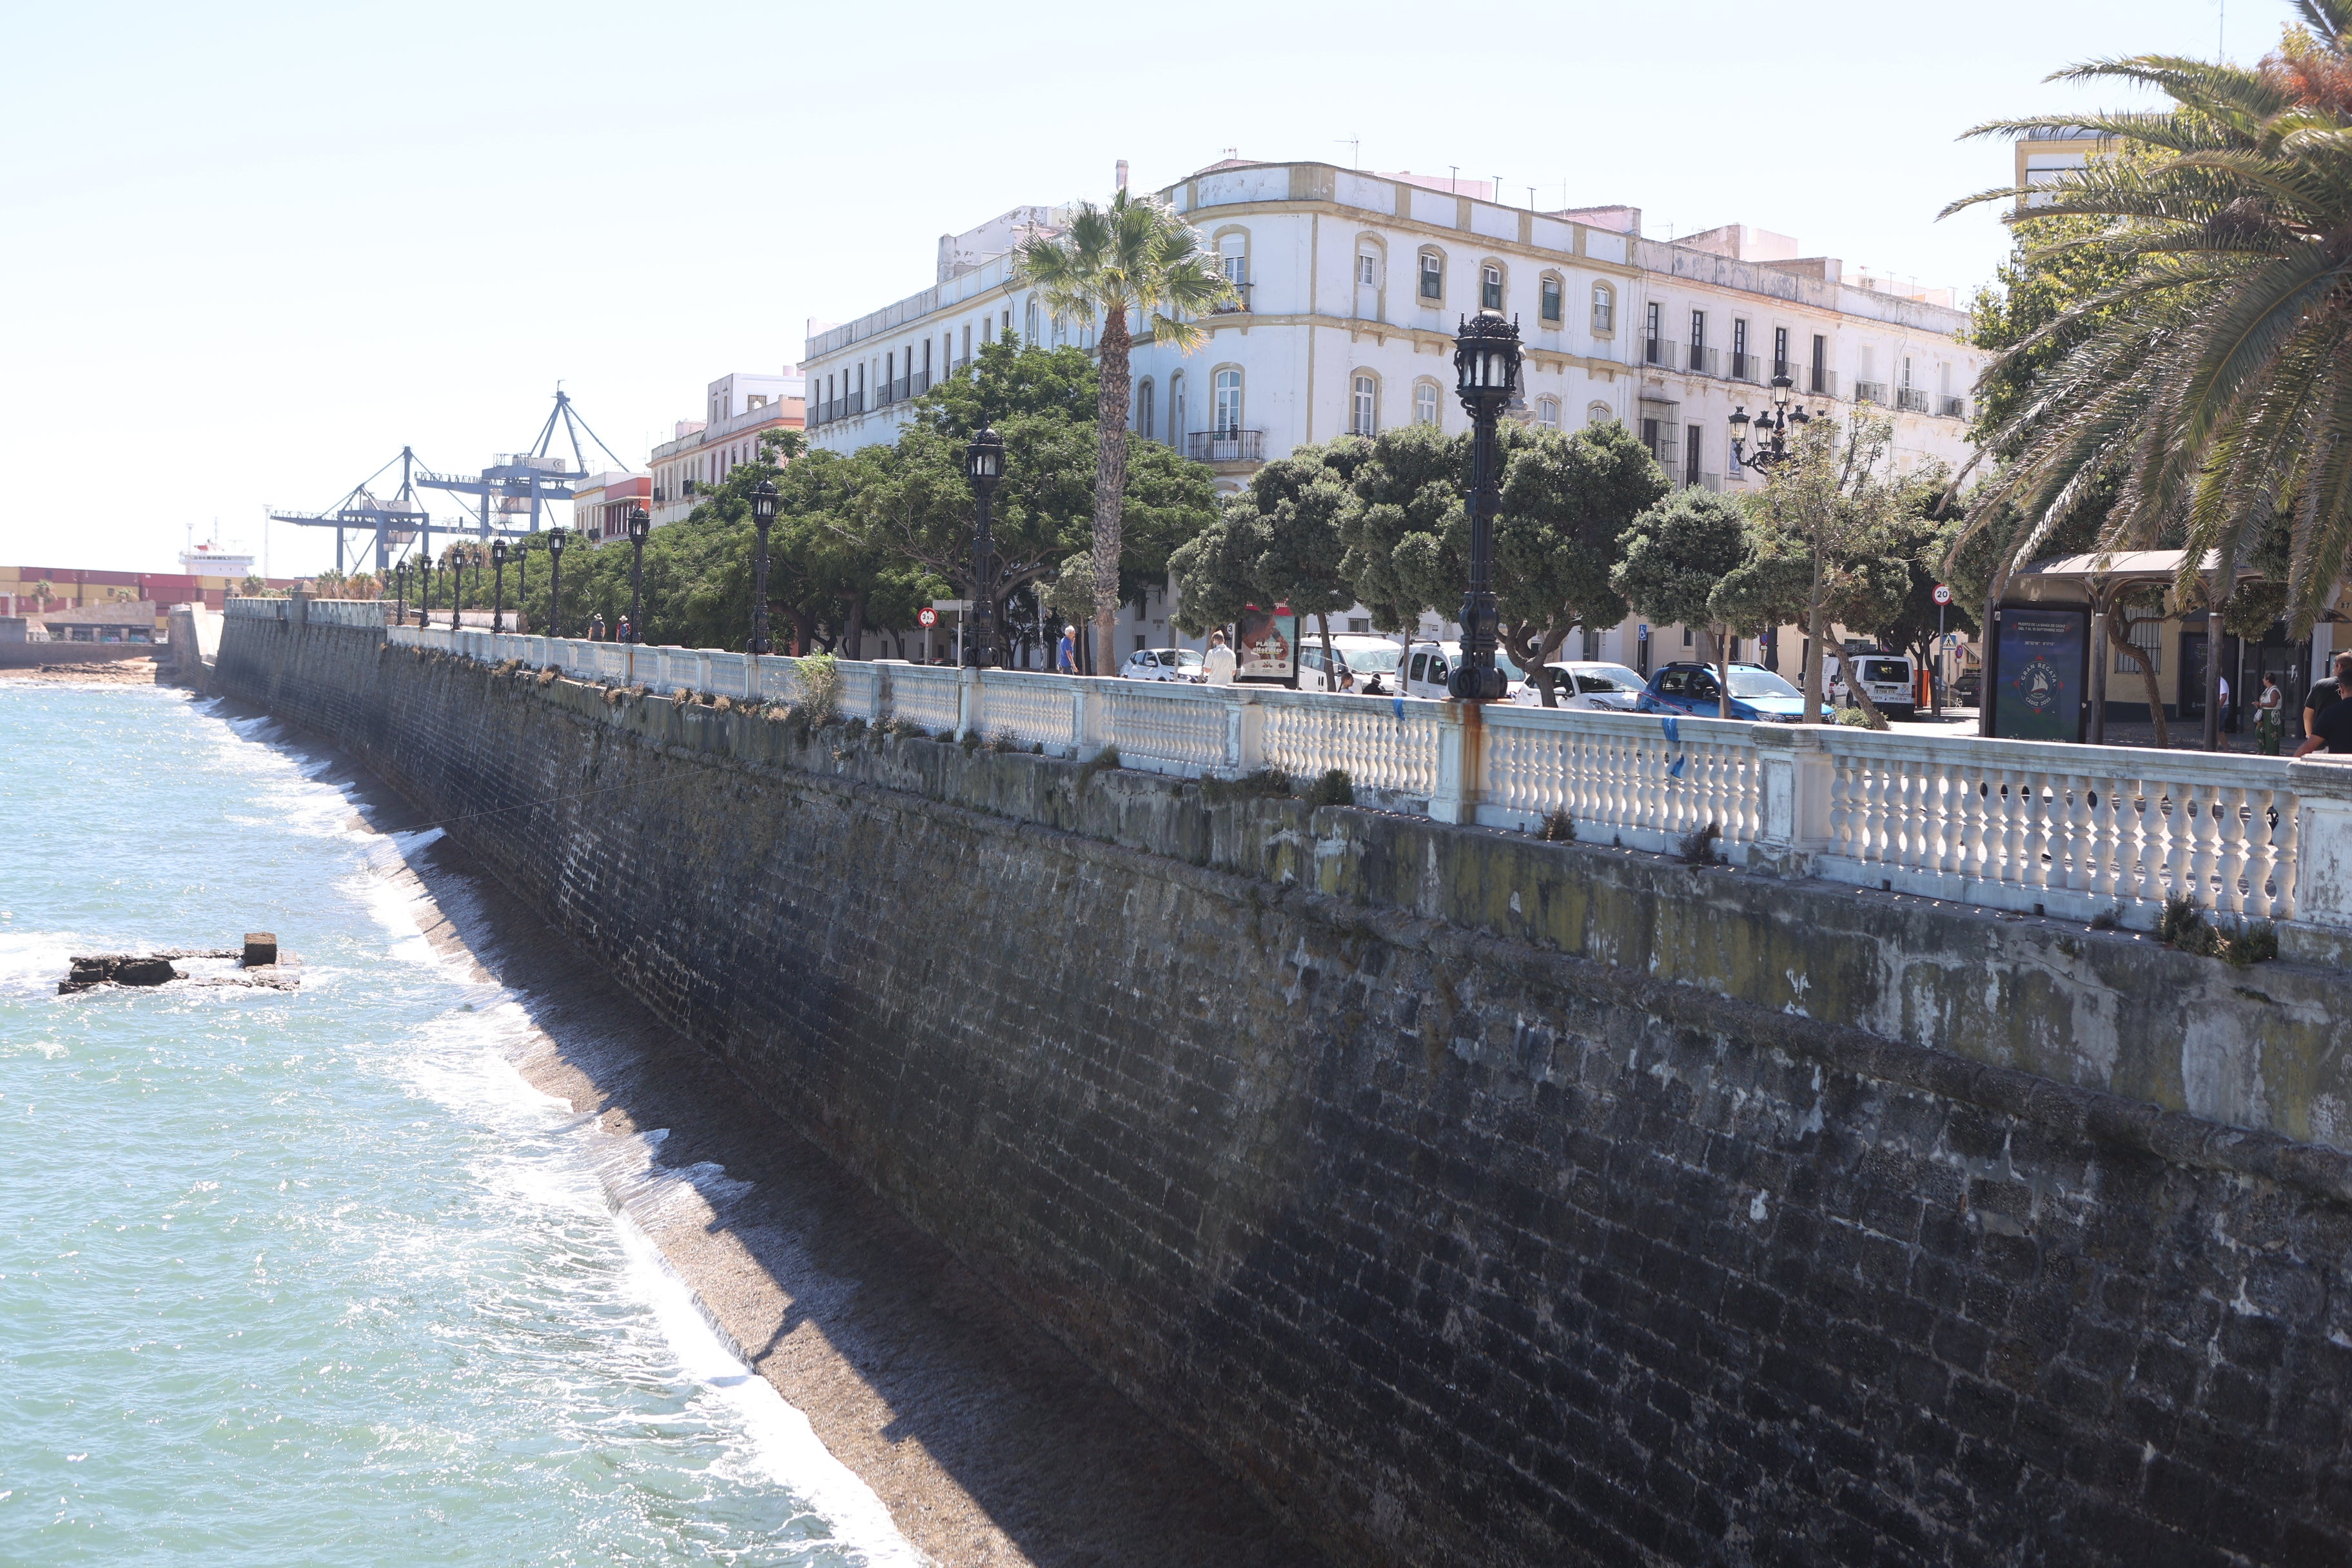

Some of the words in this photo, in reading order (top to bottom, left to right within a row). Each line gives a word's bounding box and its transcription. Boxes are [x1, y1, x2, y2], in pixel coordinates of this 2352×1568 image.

[2021, 664, 2035, 680] GRAN
[2037, 663, 2057, 683] REGATA
[2025, 697, 2039, 707] CÁDIZ
[2041, 697, 2051, 706] 2023
